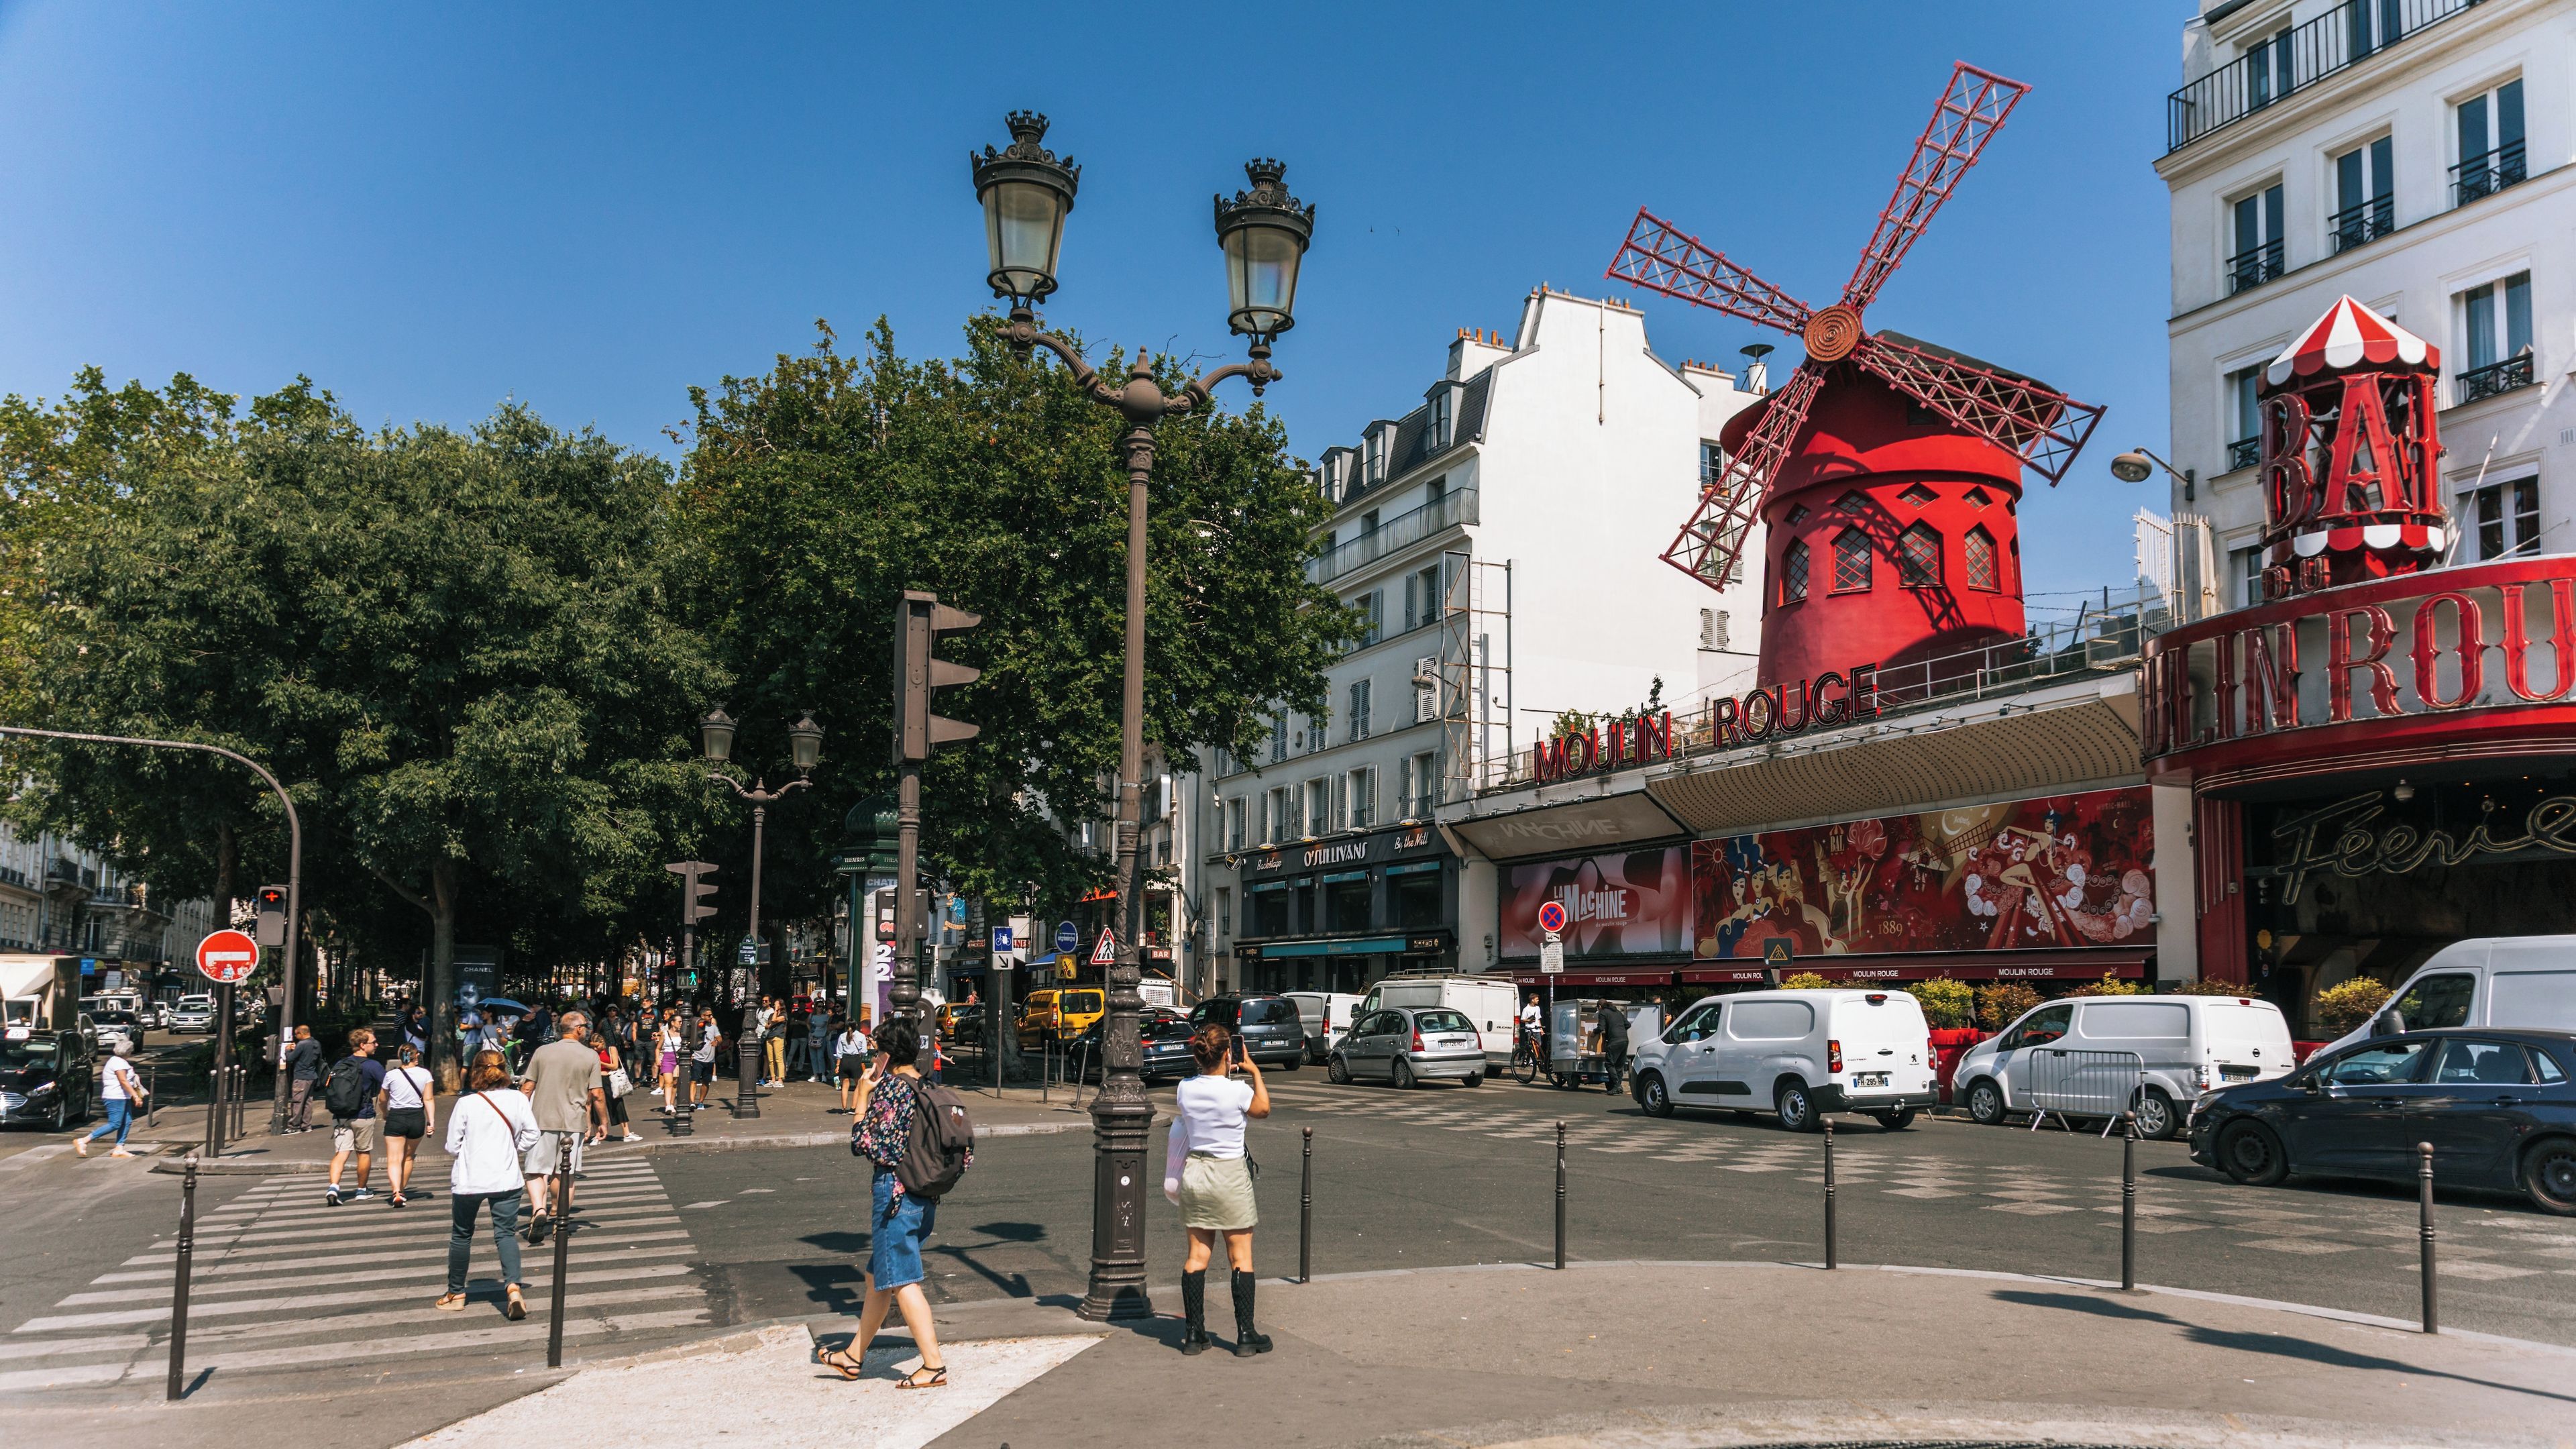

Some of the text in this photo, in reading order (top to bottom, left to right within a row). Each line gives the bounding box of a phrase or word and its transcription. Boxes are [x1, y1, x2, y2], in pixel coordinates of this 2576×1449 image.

[2261, 555, 2330, 600] DU
[1534, 662, 1881, 783] MOULIN ROUGE
[1394, 831, 1430, 853] By the Mill
[1830, 835, 1844, 853] BAL
[1304, 842, 1368, 867] O'SULLIVANS
[1256, 858, 1282, 871] Backstage
[1554, 885, 1564, 899] LA
[1878, 920, 1902, 937] 1889
[875, 945, 896, 963] 2
[1153, 951, 1169, 959] BAR
[875, 963, 896, 981] 2
[1998, 968, 2026, 976] MOULIN
